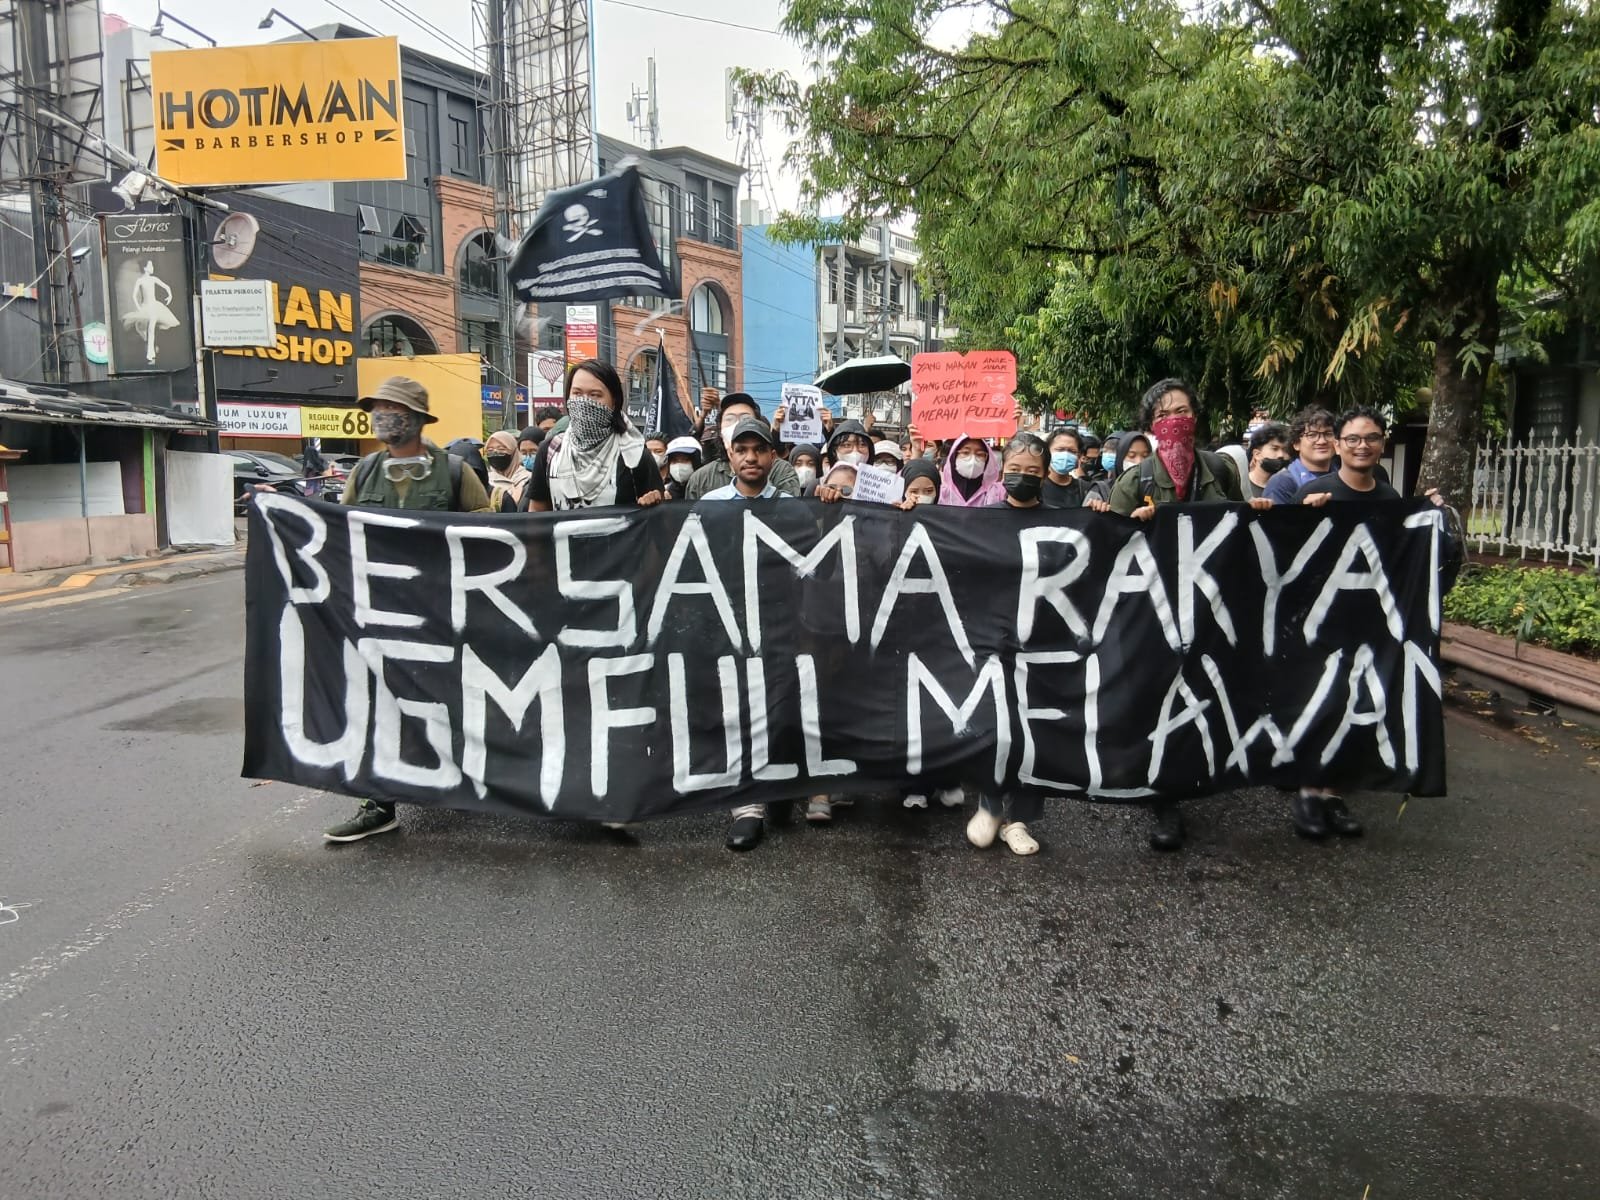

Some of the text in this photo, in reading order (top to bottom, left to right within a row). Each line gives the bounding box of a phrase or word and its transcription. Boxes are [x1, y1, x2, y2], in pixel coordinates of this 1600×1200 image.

[160, 78, 398, 130] HOTMAN
[195, 131, 363, 149] BARBERSHOP
[114, 217, 170, 238] Flores
[916, 362, 941, 374] YANG
[945, 360, 978, 371] MAKAN
[916, 381, 940, 393] YANG
[188, 407, 288, 419] PRIUM LUXURY
[965, 405, 1009, 418] PUTIH
[262, 423, 289, 431] JOGJA
[309, 411, 373, 435] REGULER 68
[251, 492, 1445, 670] BERSAMA RAKYAT
[279, 601, 1443, 811] UGM FULL MELAWAN
